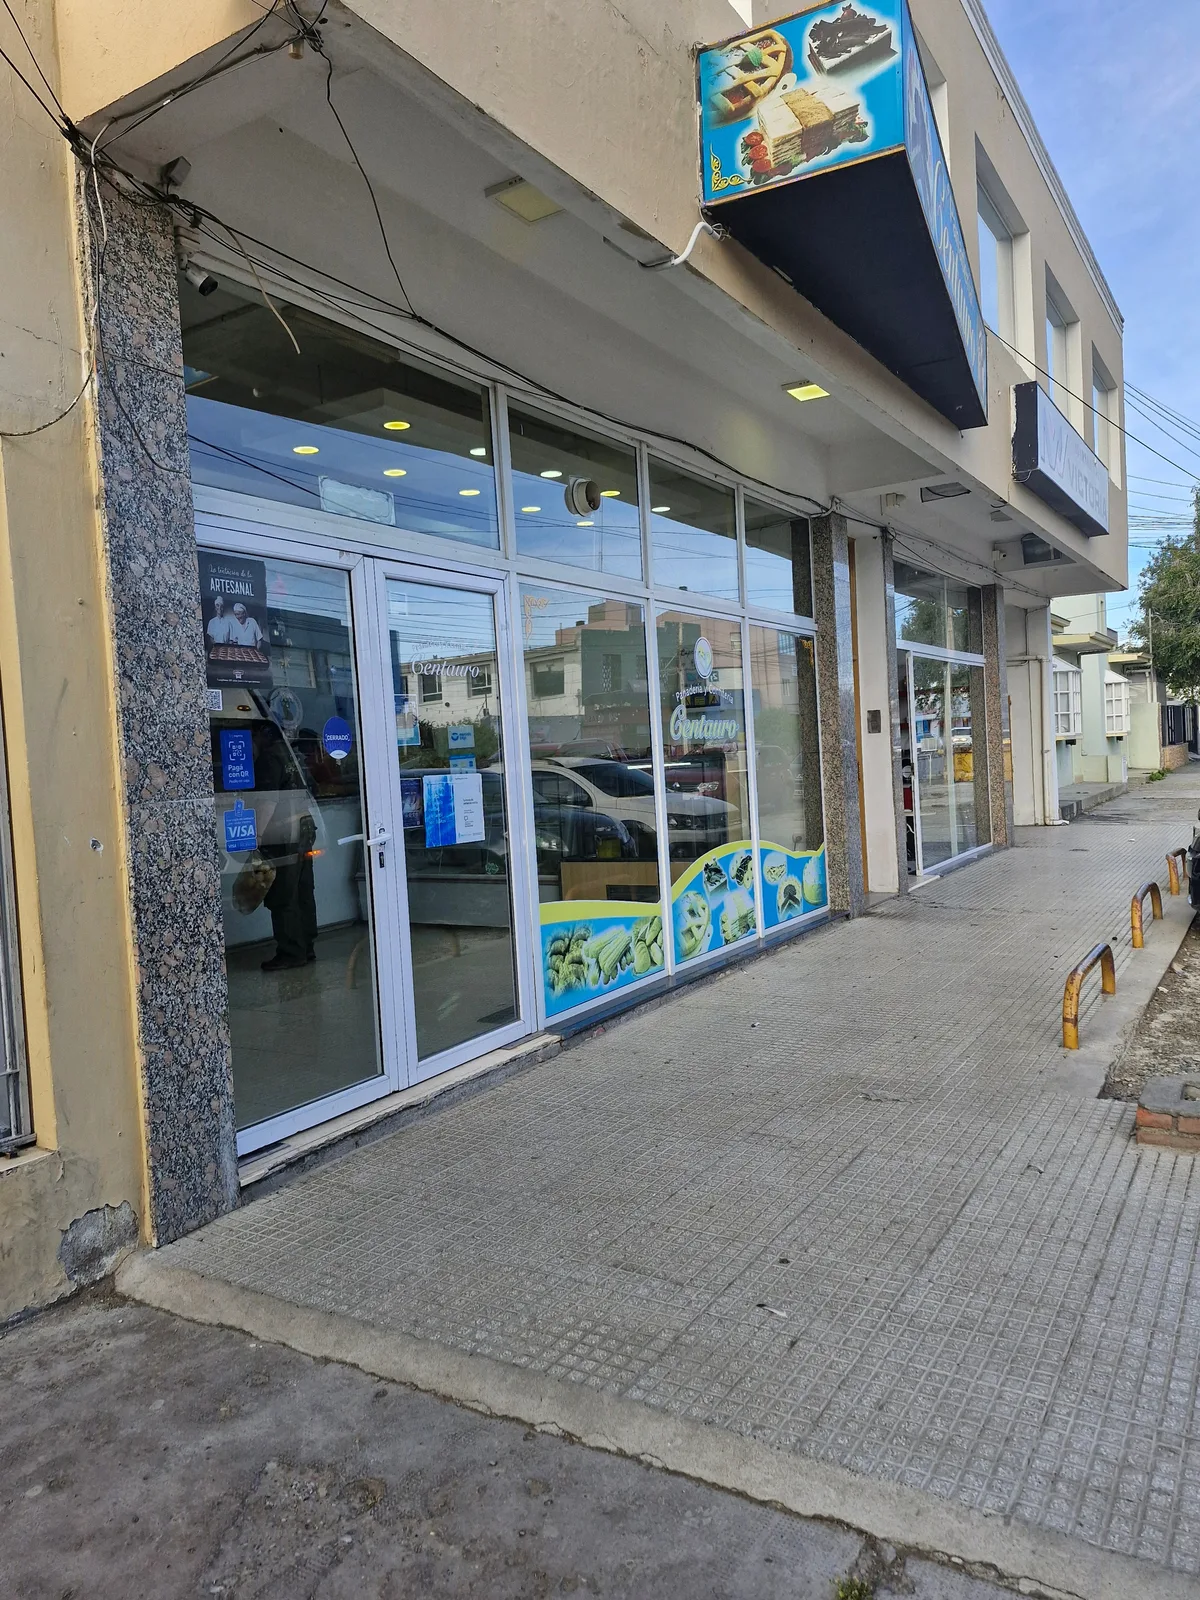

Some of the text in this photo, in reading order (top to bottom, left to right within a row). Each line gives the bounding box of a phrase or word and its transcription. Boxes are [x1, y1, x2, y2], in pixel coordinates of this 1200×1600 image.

[1068, 459, 1108, 519] VICTORIA
[210, 577, 254, 596] ARTESANAL
[410, 653, 480, 678] Centauro
[670, 704, 740, 740] Centauro
[228, 764, 244, 772] Pagá
[227, 824, 255, 838] VISA
